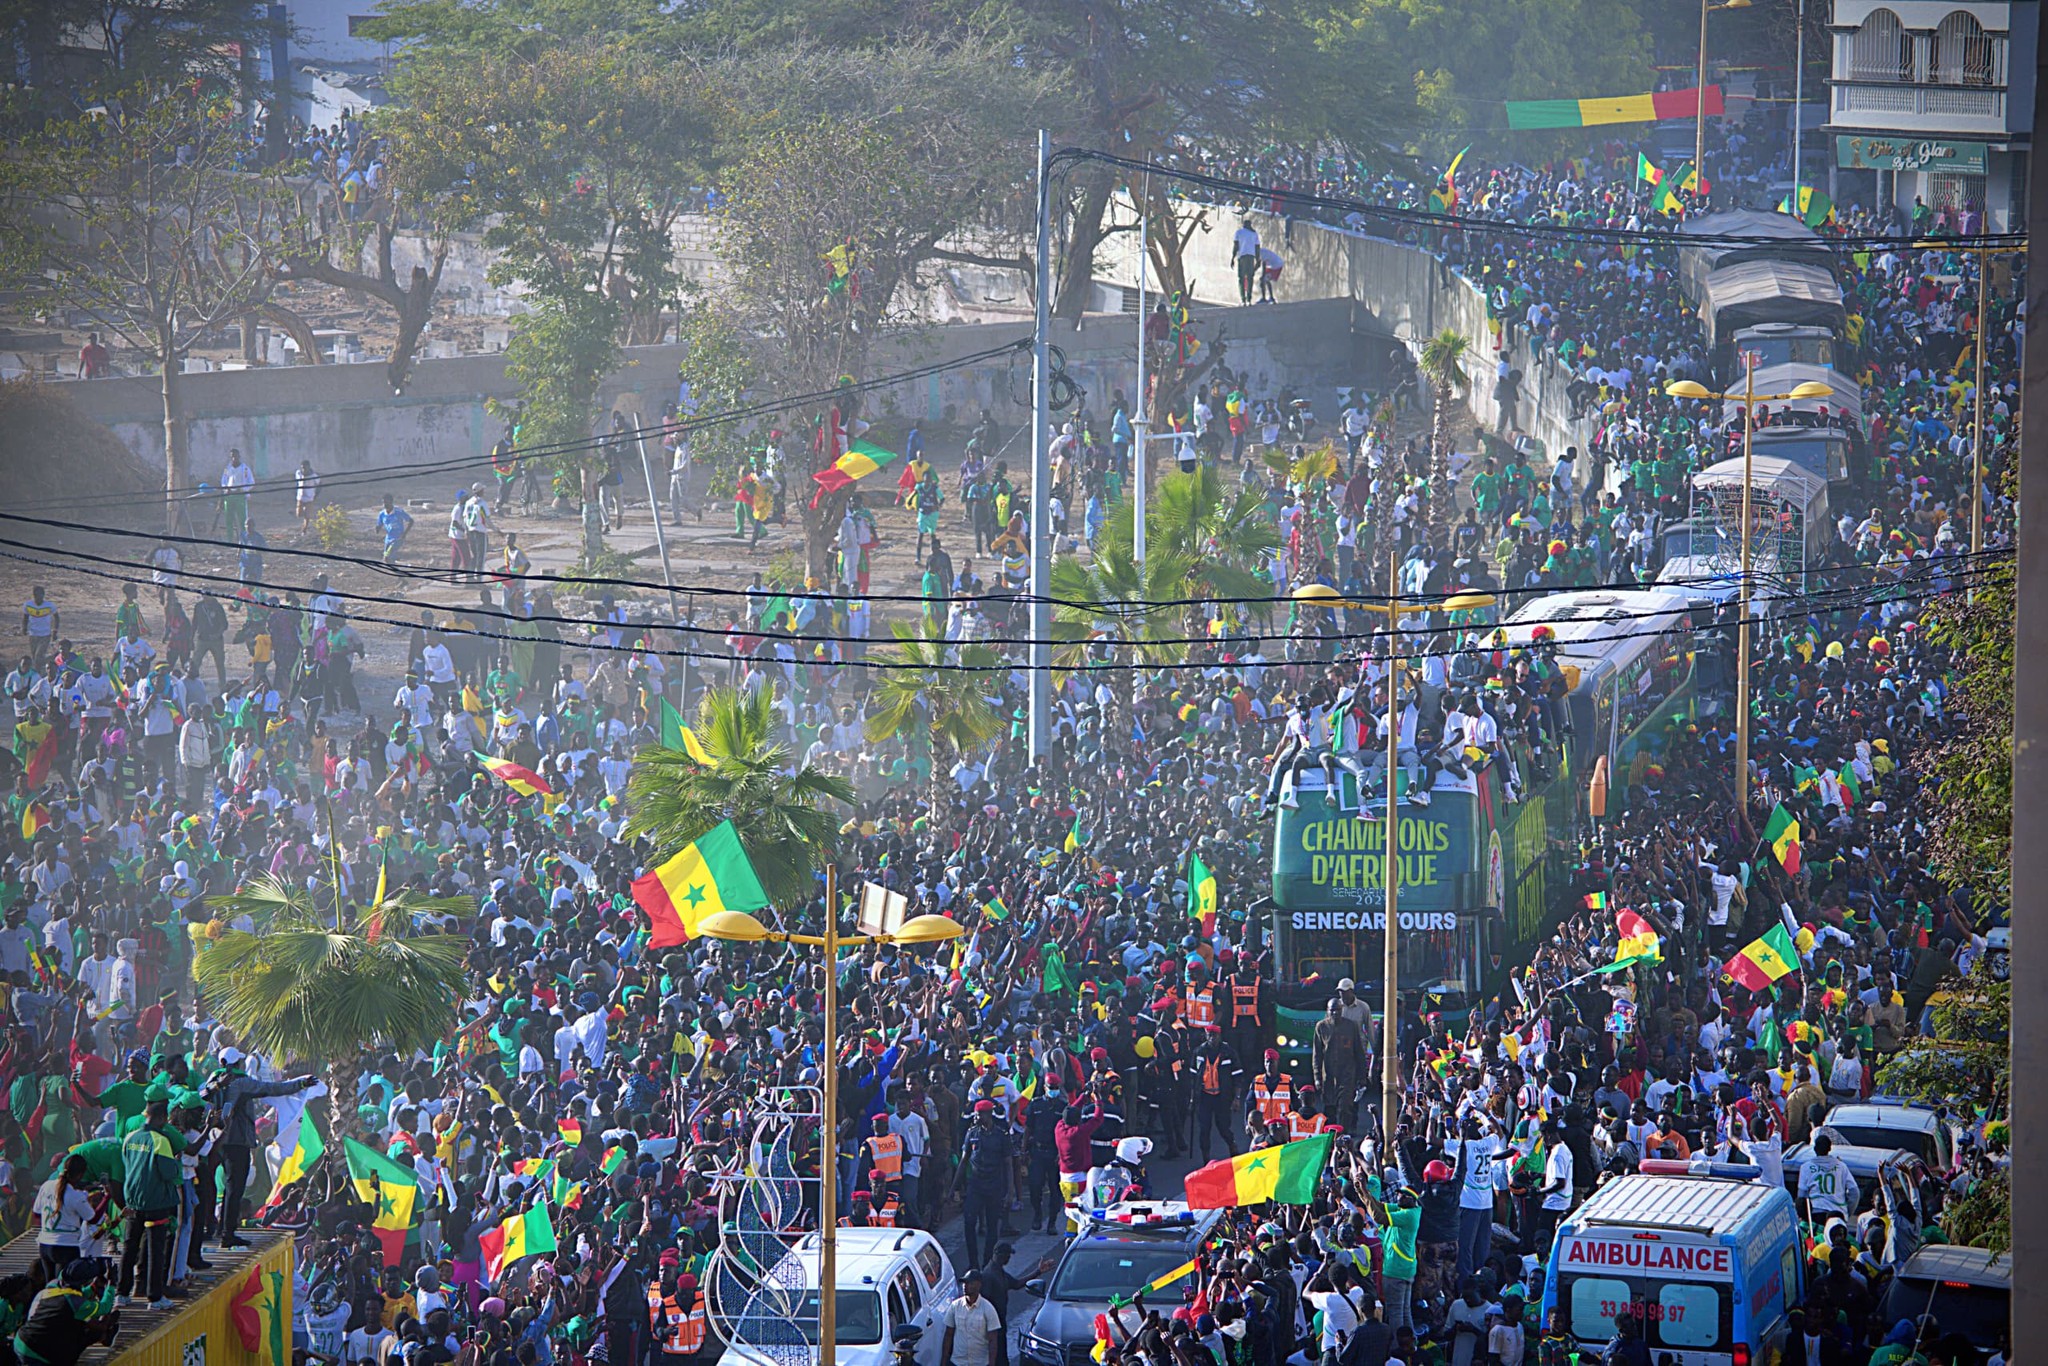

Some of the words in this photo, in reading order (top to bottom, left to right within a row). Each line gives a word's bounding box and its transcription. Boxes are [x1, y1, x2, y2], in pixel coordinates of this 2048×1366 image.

[1302, 818, 1449, 852] CHAMPONS
[1356, 895, 1387, 906] 202
[1292, 912, 1456, 931] SENECAROURS
[1234, 987, 1255, 995] POLICE
[1296, 1121, 1317, 1130] POLICE
[878, 1141, 897, 1150] POLICE
[1474, 1154, 1491, 1175] 25
[1814, 1173, 1836, 1195] 10
[1568, 1241, 1729, 1272] AMBULANCE
[1600, 1300, 1616, 1317] 33
[1648, 1303, 1665, 1321] 98
[1669, 1305, 1685, 1323] 97
